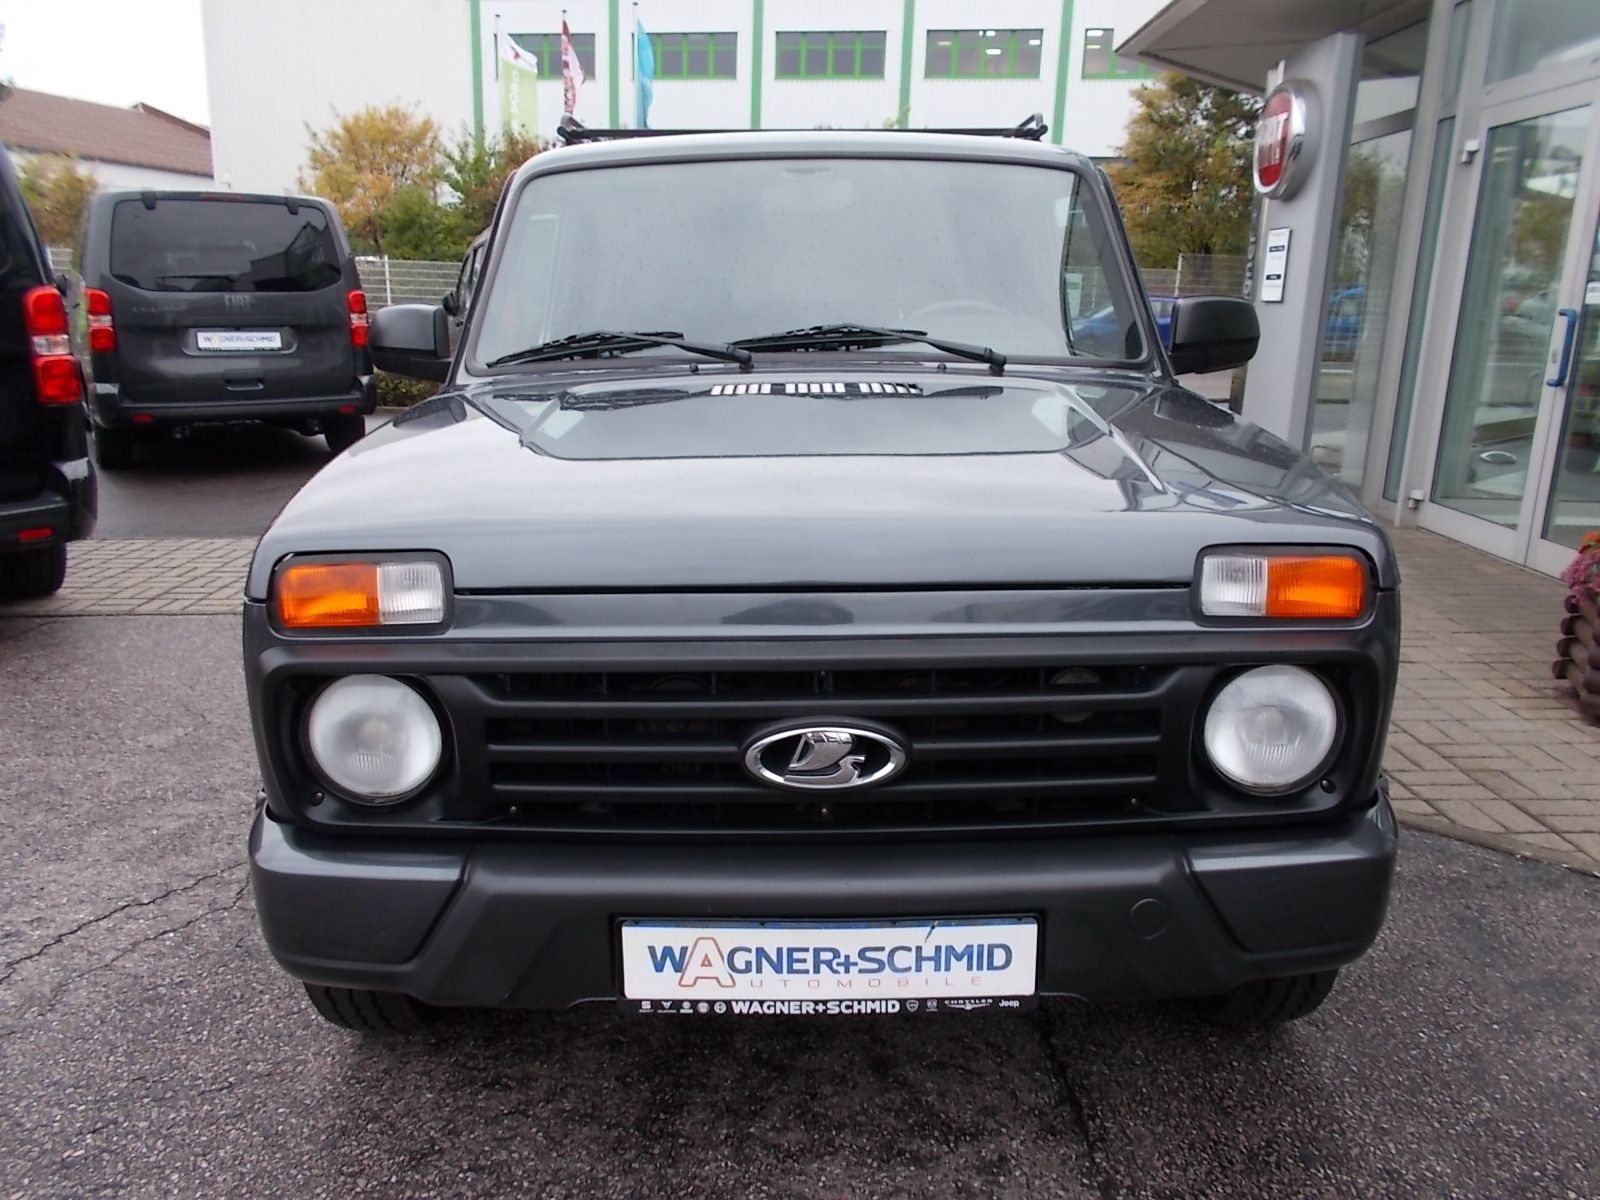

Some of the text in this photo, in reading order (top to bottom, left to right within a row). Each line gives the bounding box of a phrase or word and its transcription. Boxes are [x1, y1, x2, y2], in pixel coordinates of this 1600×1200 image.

[224, 294, 250, 312] FIAT
[648, 937, 1012, 988] WAGNER+SCHMID
[731, 1000, 900, 1015] WAGNER+SCHMID
[999, 998, 1020, 1008] Jeep
